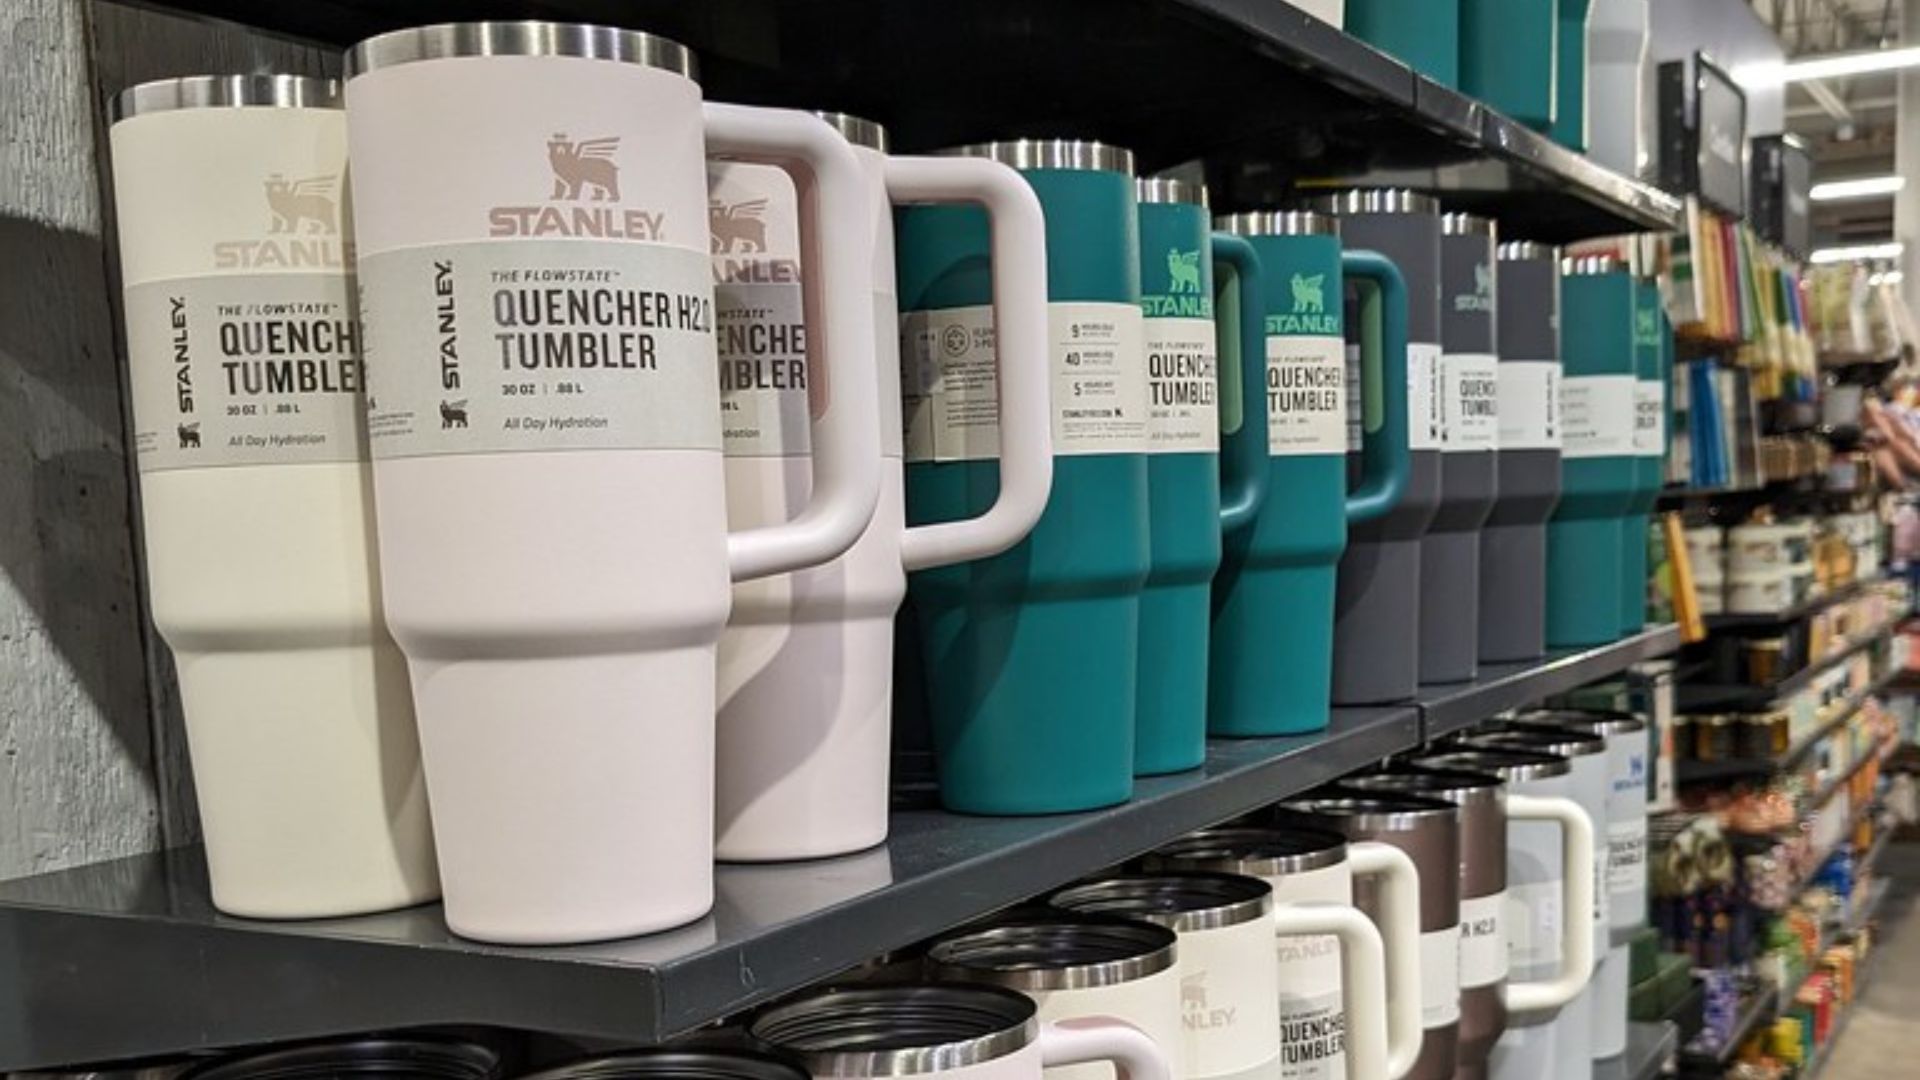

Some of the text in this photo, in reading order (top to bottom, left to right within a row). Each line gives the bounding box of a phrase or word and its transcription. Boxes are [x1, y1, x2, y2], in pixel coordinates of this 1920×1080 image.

[491, 270, 519, 283] THE
[217, 305, 242, 317] THE
[493, 288, 671, 328] QUENCHER
[219, 320, 364, 357] QUENCH
[495, 332, 658, 371] TUMBLER
[1065, 352, 1081, 366] 40
[222, 359, 367, 396] TUMBLE
[502, 384, 517, 396] 30
[520, 383, 536, 395] OZ
[503, 416, 608, 431] All Day Hydration
